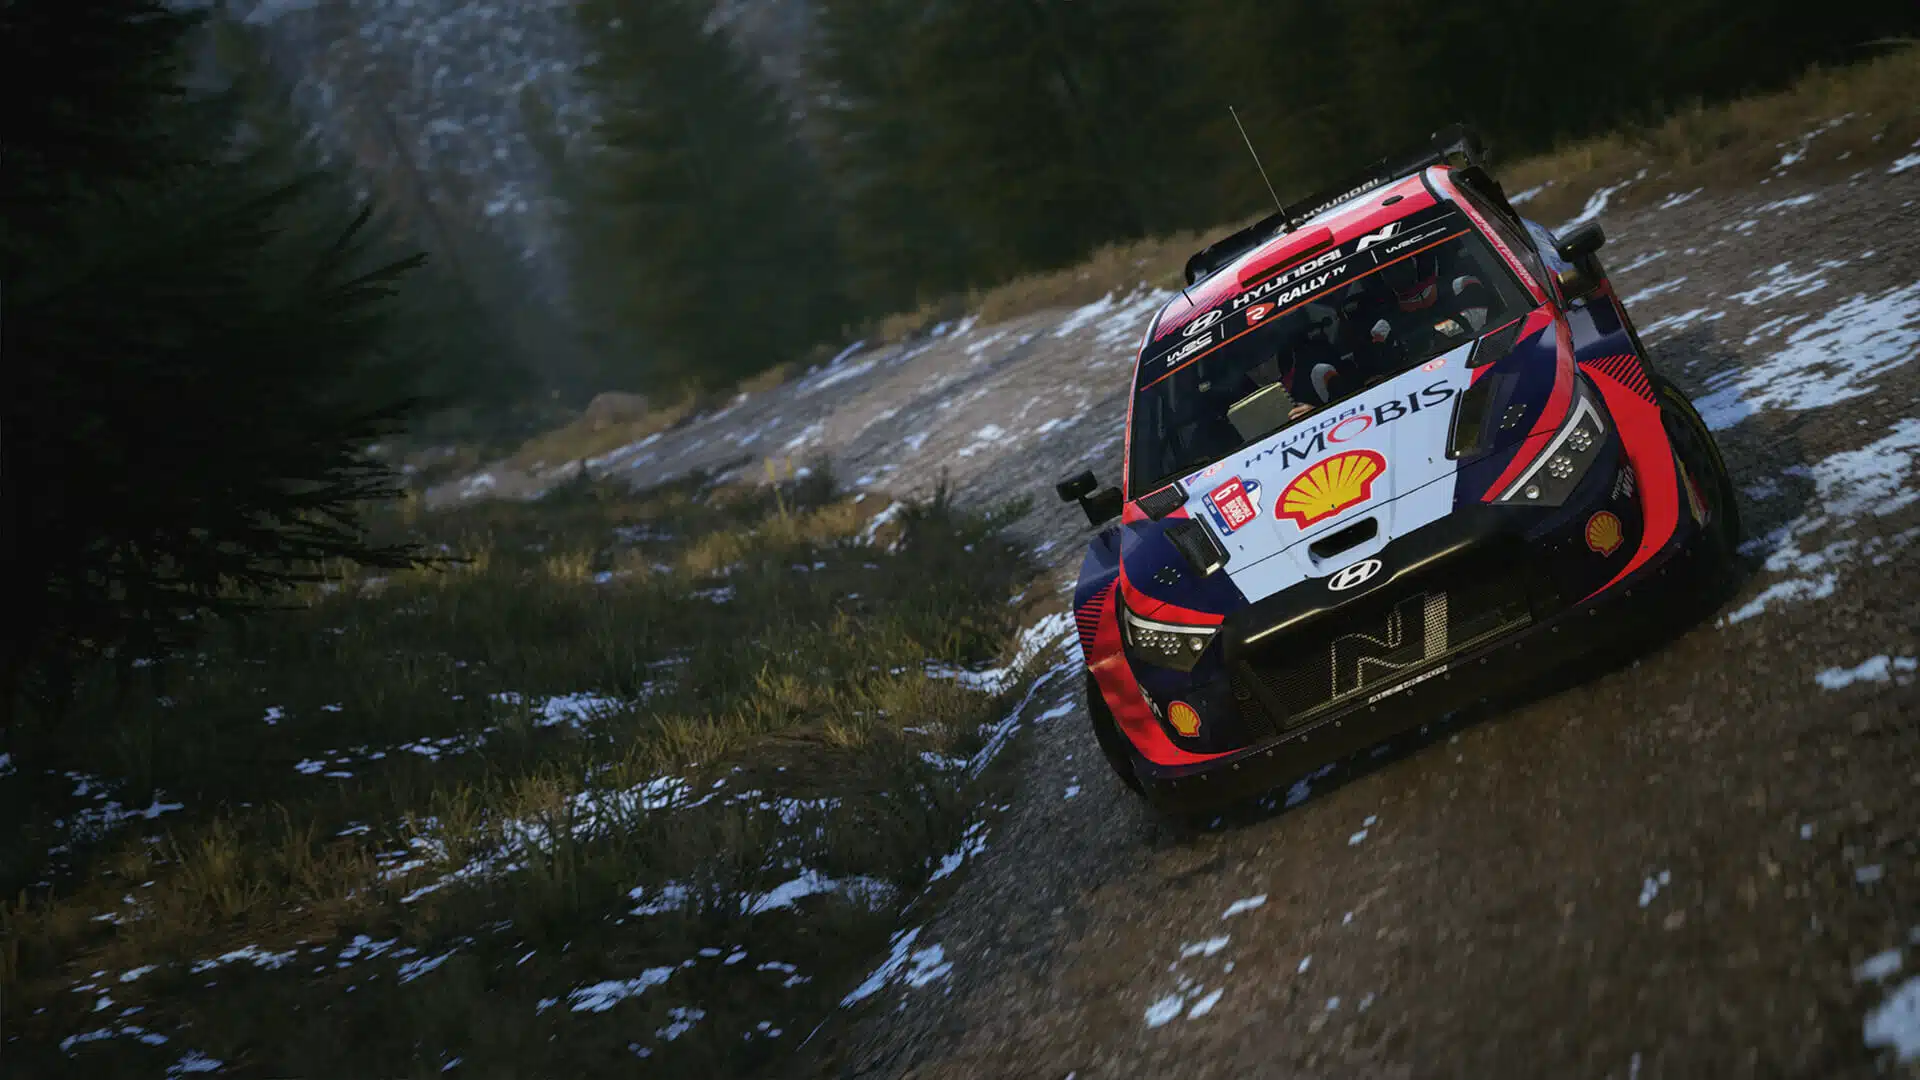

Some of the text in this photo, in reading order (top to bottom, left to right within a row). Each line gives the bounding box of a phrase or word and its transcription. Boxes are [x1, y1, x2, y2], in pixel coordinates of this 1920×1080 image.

[1303, 178, 1379, 219] HYUNDAI
[1385, 234, 1423, 254] WRC
[1233, 249, 1342, 309] HYUNDAI
[1277, 272, 1330, 307] RALLY
[1245, 404, 1365, 468] HYUNDAI
[1281, 379, 1455, 470] MOBIS
[1214, 483, 1239, 501] 6
